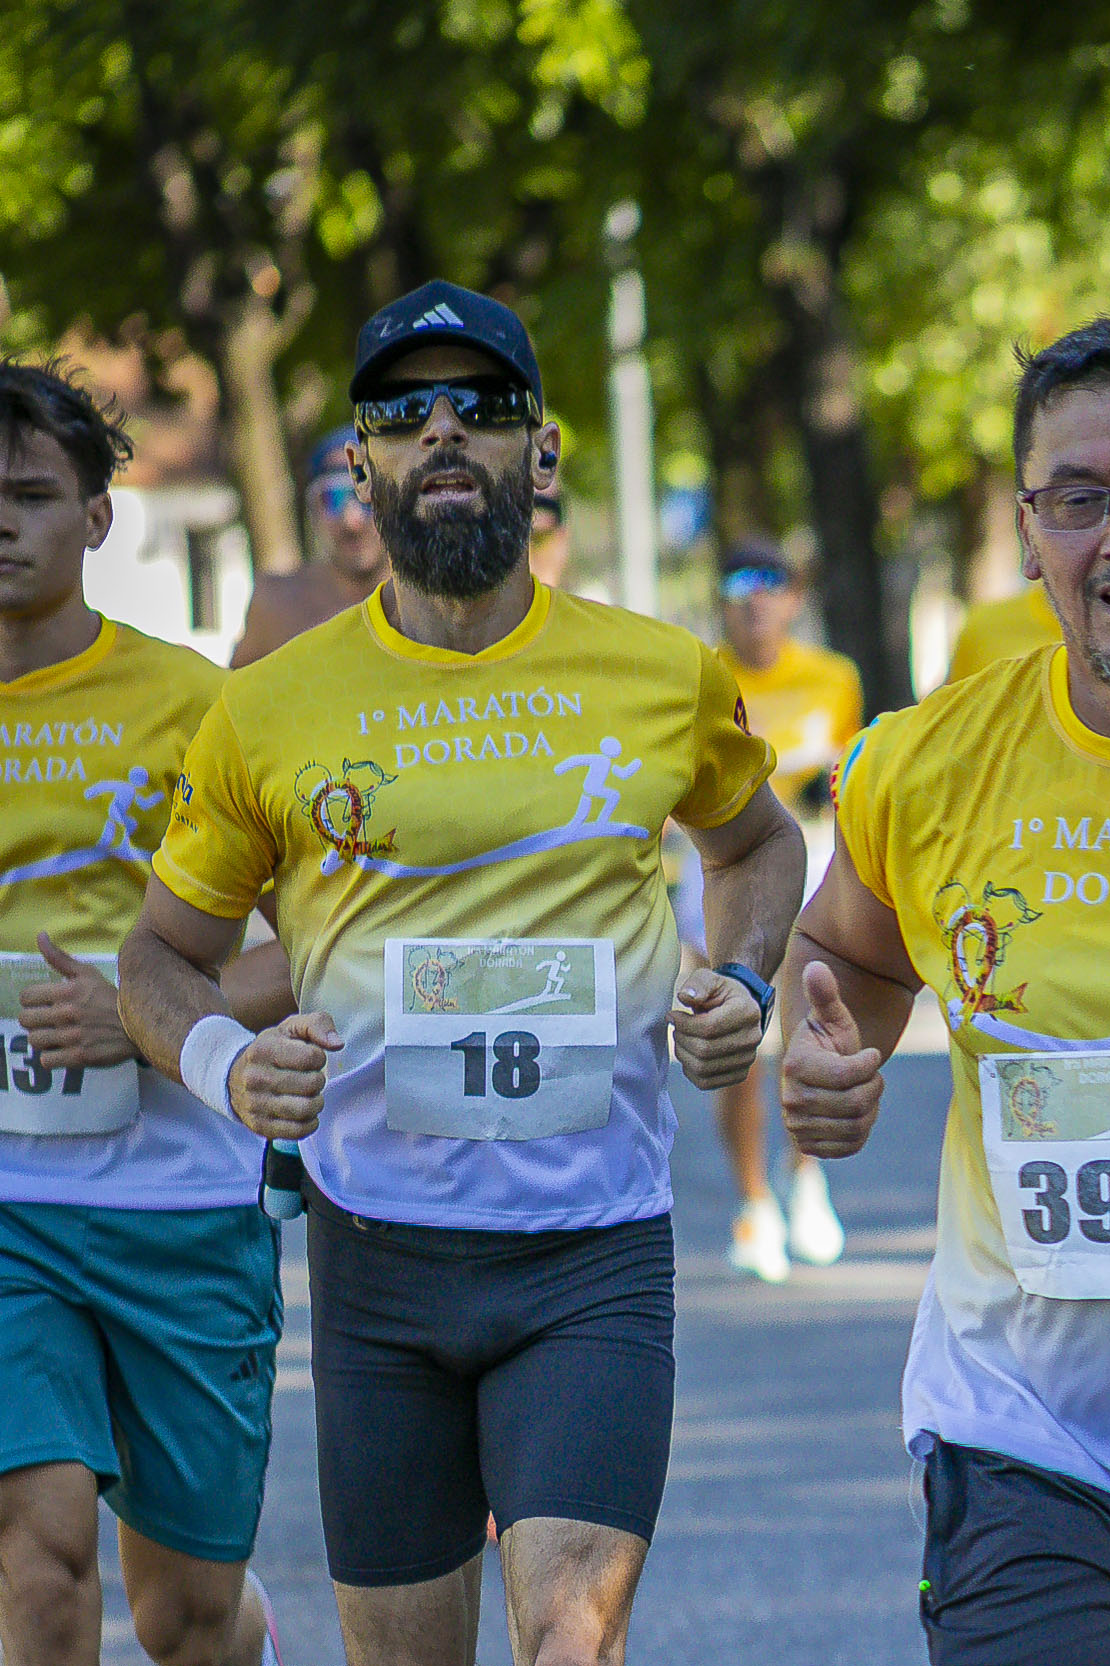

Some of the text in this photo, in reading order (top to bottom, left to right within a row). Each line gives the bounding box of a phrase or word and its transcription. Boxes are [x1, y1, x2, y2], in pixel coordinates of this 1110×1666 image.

[397, 687, 583, 730] MARATÓN
[0, 756, 87, 783] RADA
[394, 732, 554, 769] DORADA
[450, 1030, 542, 1099] 18
